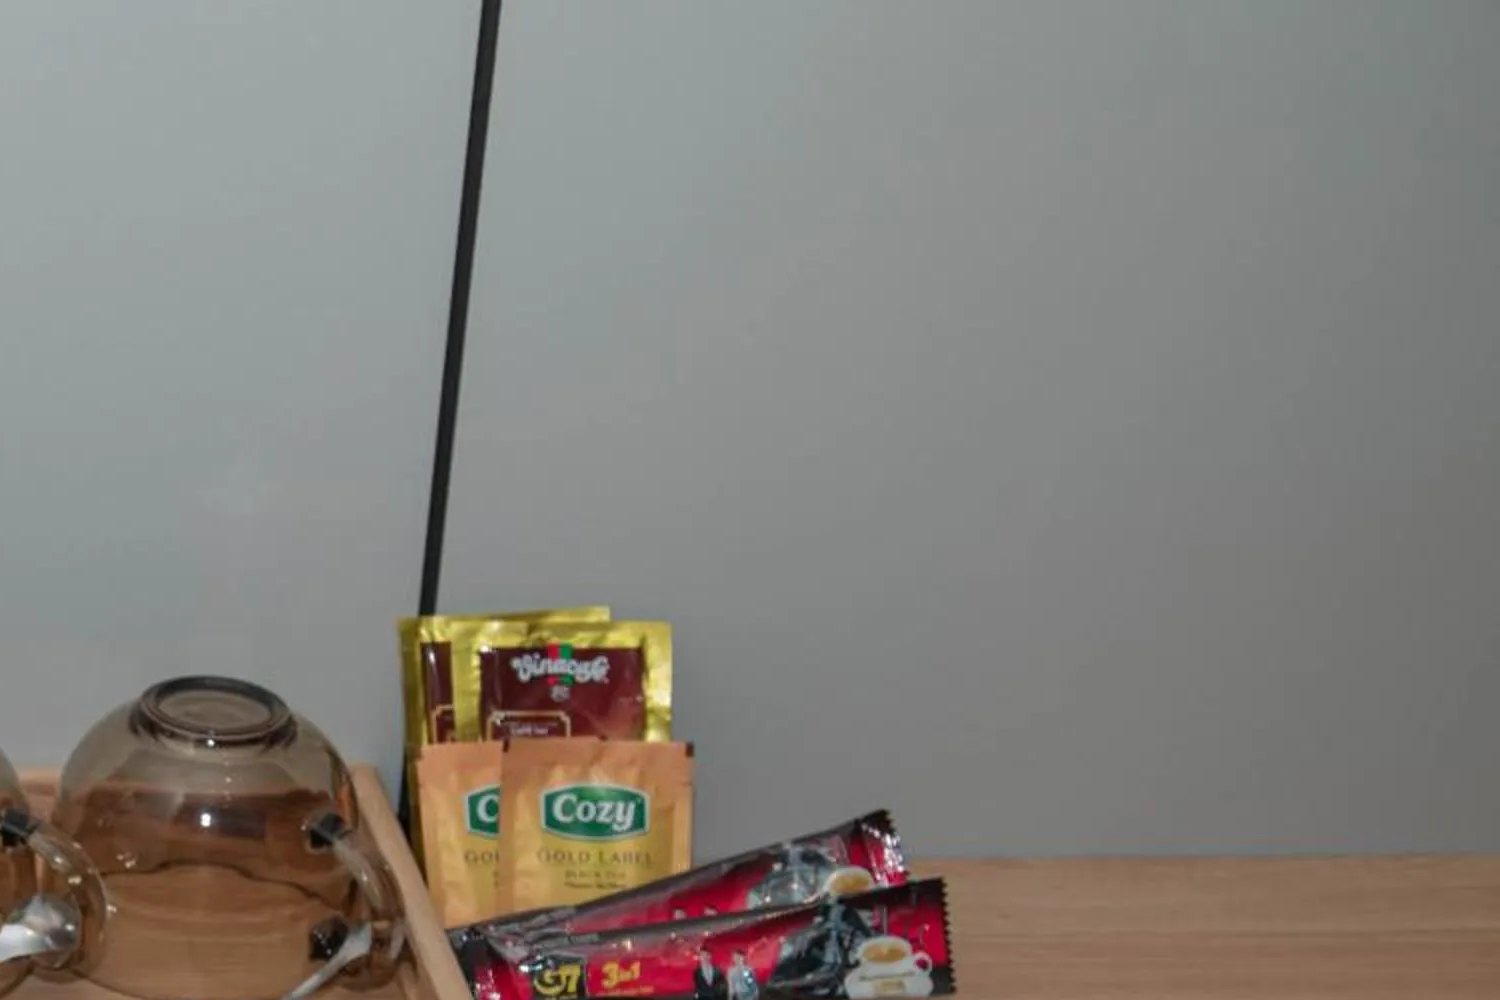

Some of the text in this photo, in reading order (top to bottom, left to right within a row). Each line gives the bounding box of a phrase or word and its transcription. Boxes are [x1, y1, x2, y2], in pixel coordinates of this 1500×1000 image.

[552, 793, 637, 832] Cozy
[537, 849, 655, 866] GOLD LABEL
